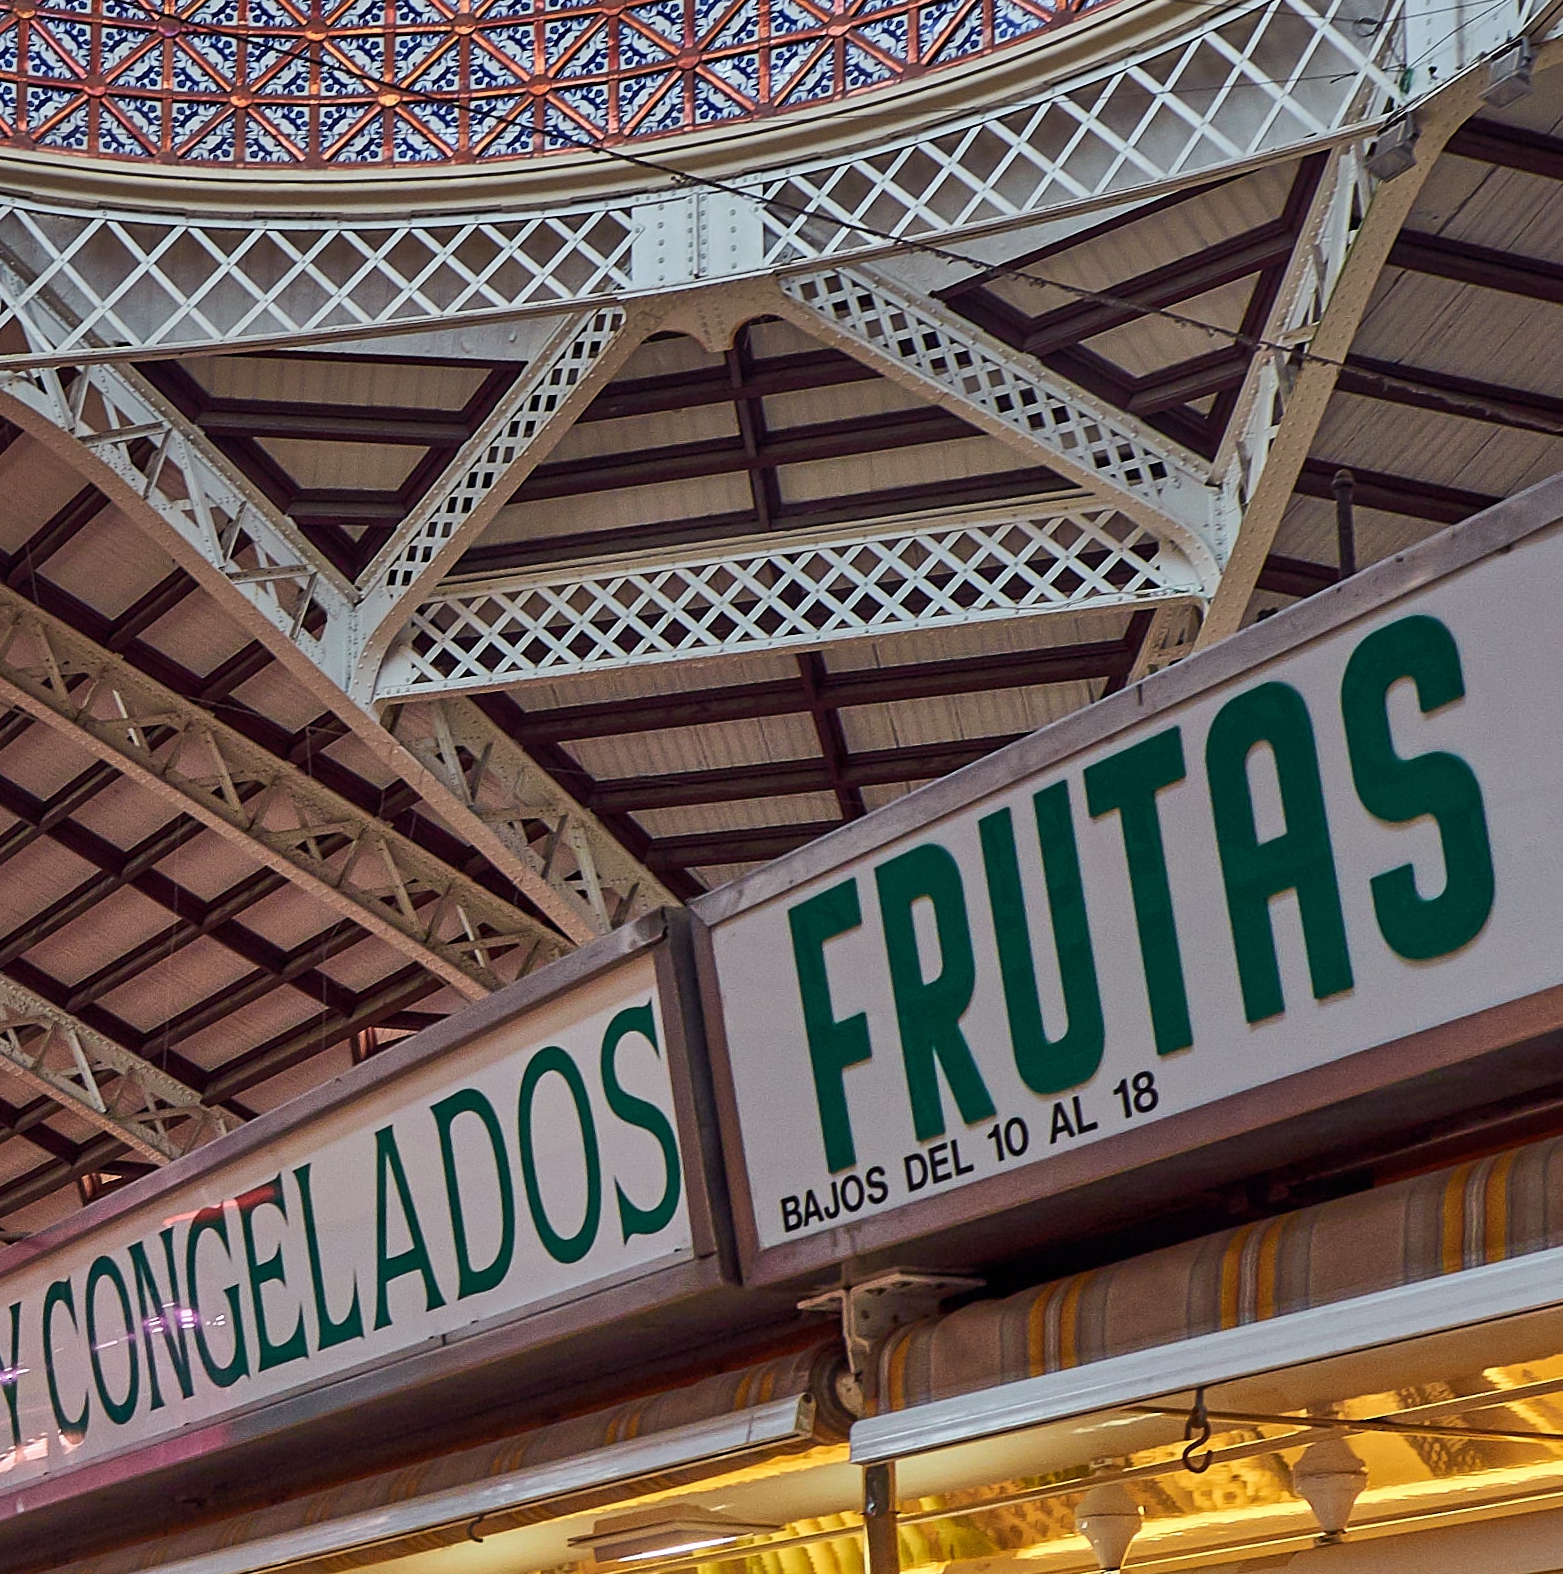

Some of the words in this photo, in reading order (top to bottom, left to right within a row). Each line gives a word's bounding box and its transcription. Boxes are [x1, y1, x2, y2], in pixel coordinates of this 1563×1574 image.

[789, 614, 1497, 1175] FRUTAS
[42, 999, 683, 1447] CONGELADOS
[780, 1166, 889, 1233] BAJOS
[903, 1139, 975, 1192] DEL
[986, 1116, 1030, 1162] 10
[1049, 1095, 1098, 1145] AL
[1113, 1070, 1160, 1119] 18
